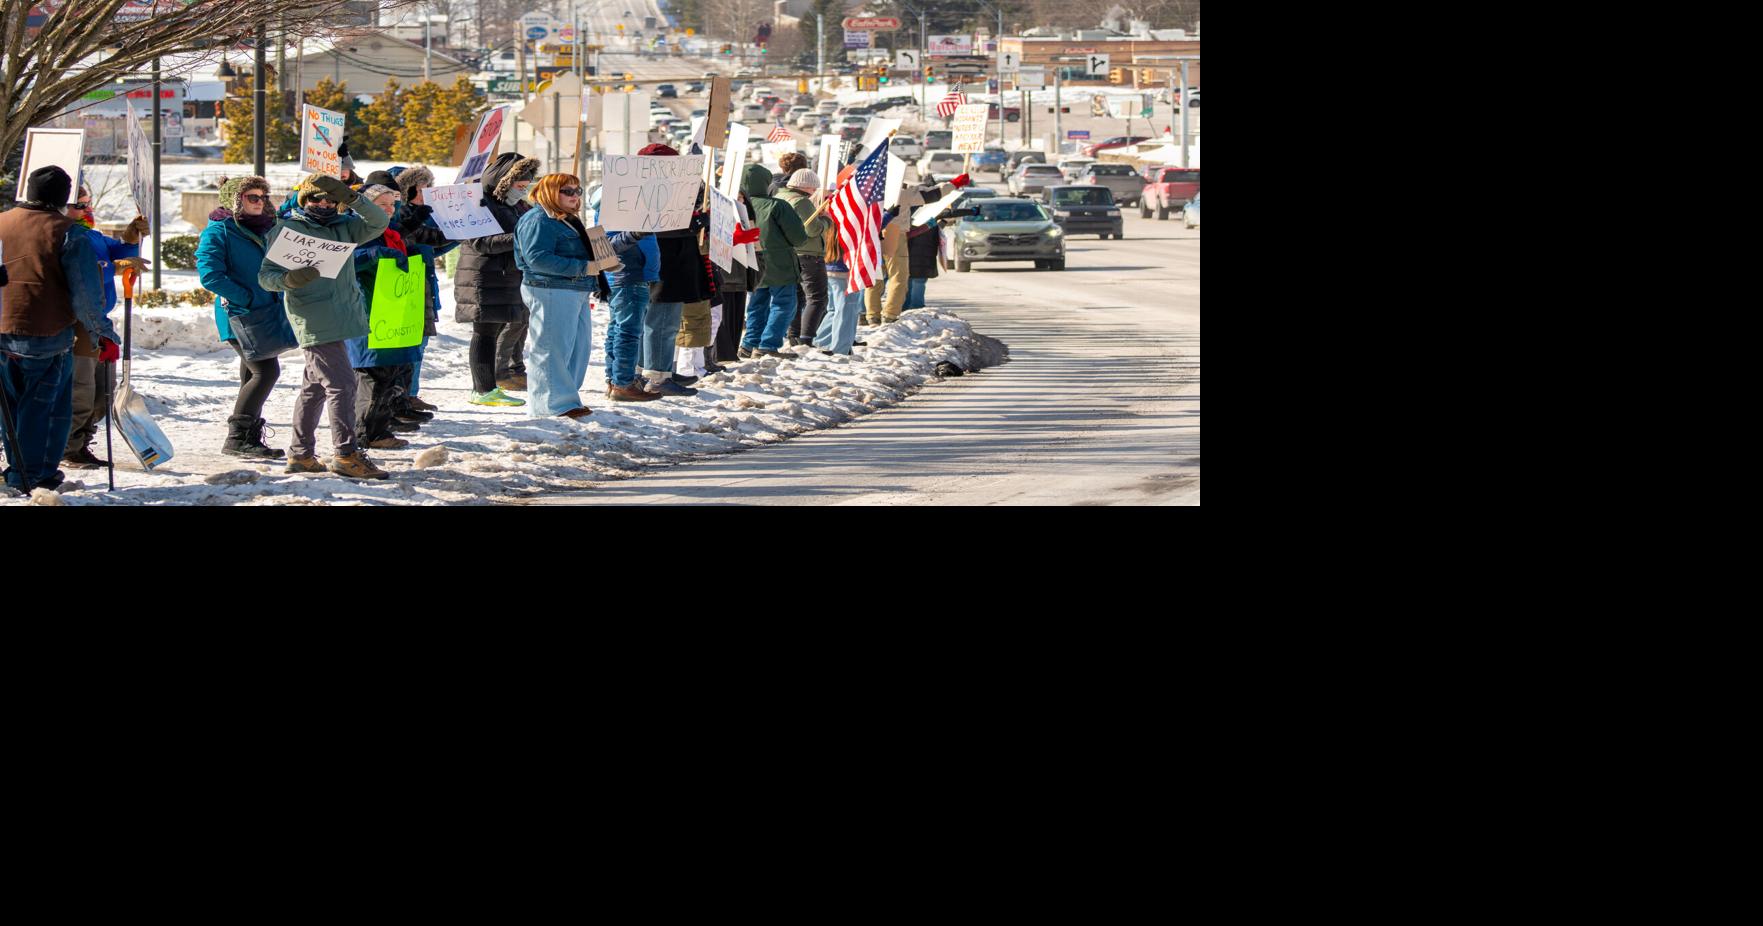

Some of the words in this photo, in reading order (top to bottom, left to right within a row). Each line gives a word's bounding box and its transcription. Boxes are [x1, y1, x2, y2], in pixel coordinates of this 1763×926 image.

[308, 109, 320, 121] NO
[320, 111, 344, 126] THUGS
[307, 147, 316, 156] IN
[322, 150, 337, 161] OUR
[306, 157, 340, 175] HOLLERS
[603, 156, 629, 176] NO
[430, 187, 473, 201] Justice
[617, 183, 669, 213] END
[283, 231, 316, 248] LIAR
[317, 242, 350, 253] NOEM
[282, 252, 325, 268] HOME
[299, 248, 317, 259] GO
[394, 271, 423, 298] OBEY
